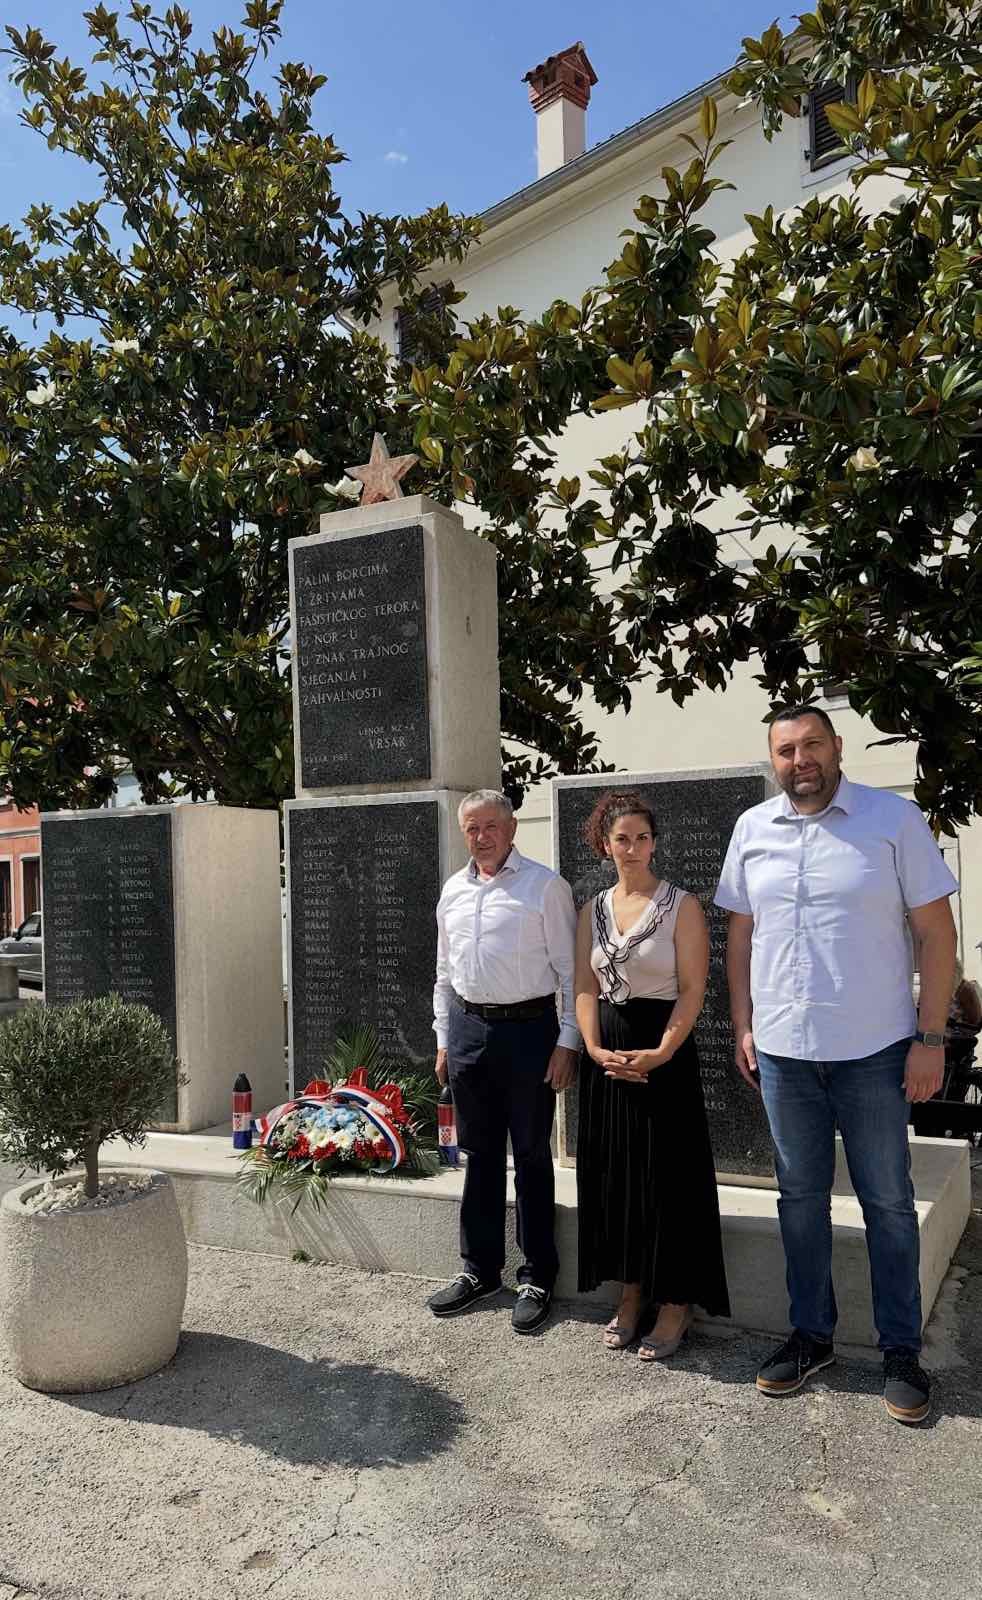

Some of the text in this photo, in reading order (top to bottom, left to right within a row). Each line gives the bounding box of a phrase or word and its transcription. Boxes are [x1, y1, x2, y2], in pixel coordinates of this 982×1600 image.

[374, 600, 420, 617] TERORA
[301, 642, 409, 666] U ZNAK TRAJNOG
[303, 686, 383, 706] ZAHVALNOSTI
[368, 736, 408, 750] VRSAR
[682, 848, 721, 857] ANTON
